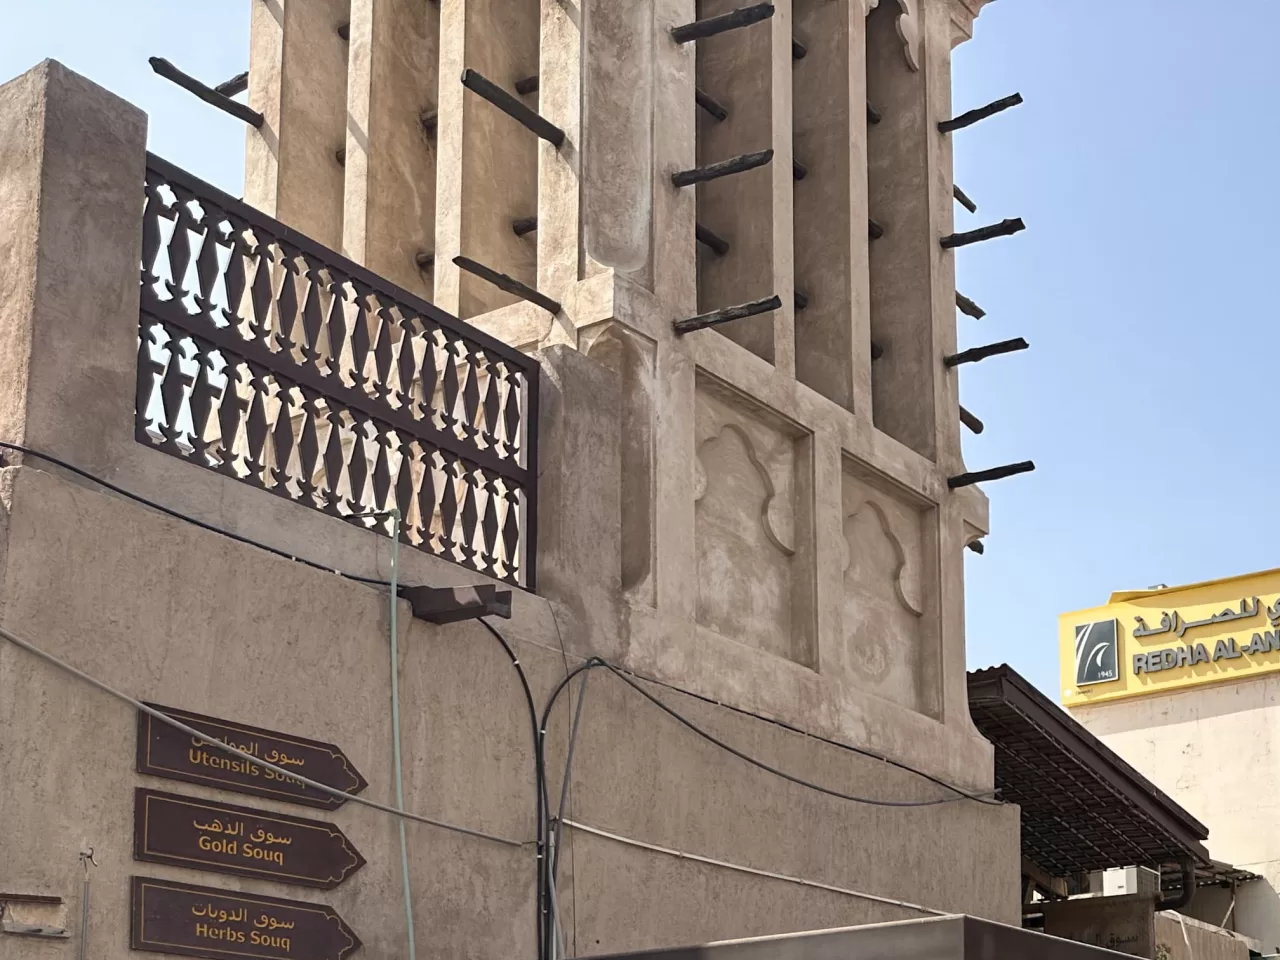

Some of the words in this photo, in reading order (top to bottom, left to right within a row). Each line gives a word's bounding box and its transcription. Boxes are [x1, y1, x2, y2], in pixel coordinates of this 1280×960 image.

[1133, 596, 1260, 638] للصرافة
[1133, 642, 1209, 676] REDHA
[1098, 670, 1113, 679] 1945
[189, 748, 260, 777] Utensils
[264, 749, 305, 766] سوق
[250, 825, 292, 845] سوق
[199, 835, 238, 855] Gold
[242, 843, 284, 866] Souq
[253, 910, 295, 930] سوق
[195, 923, 246, 943] Herbs
[250, 930, 291, 953] Souq
